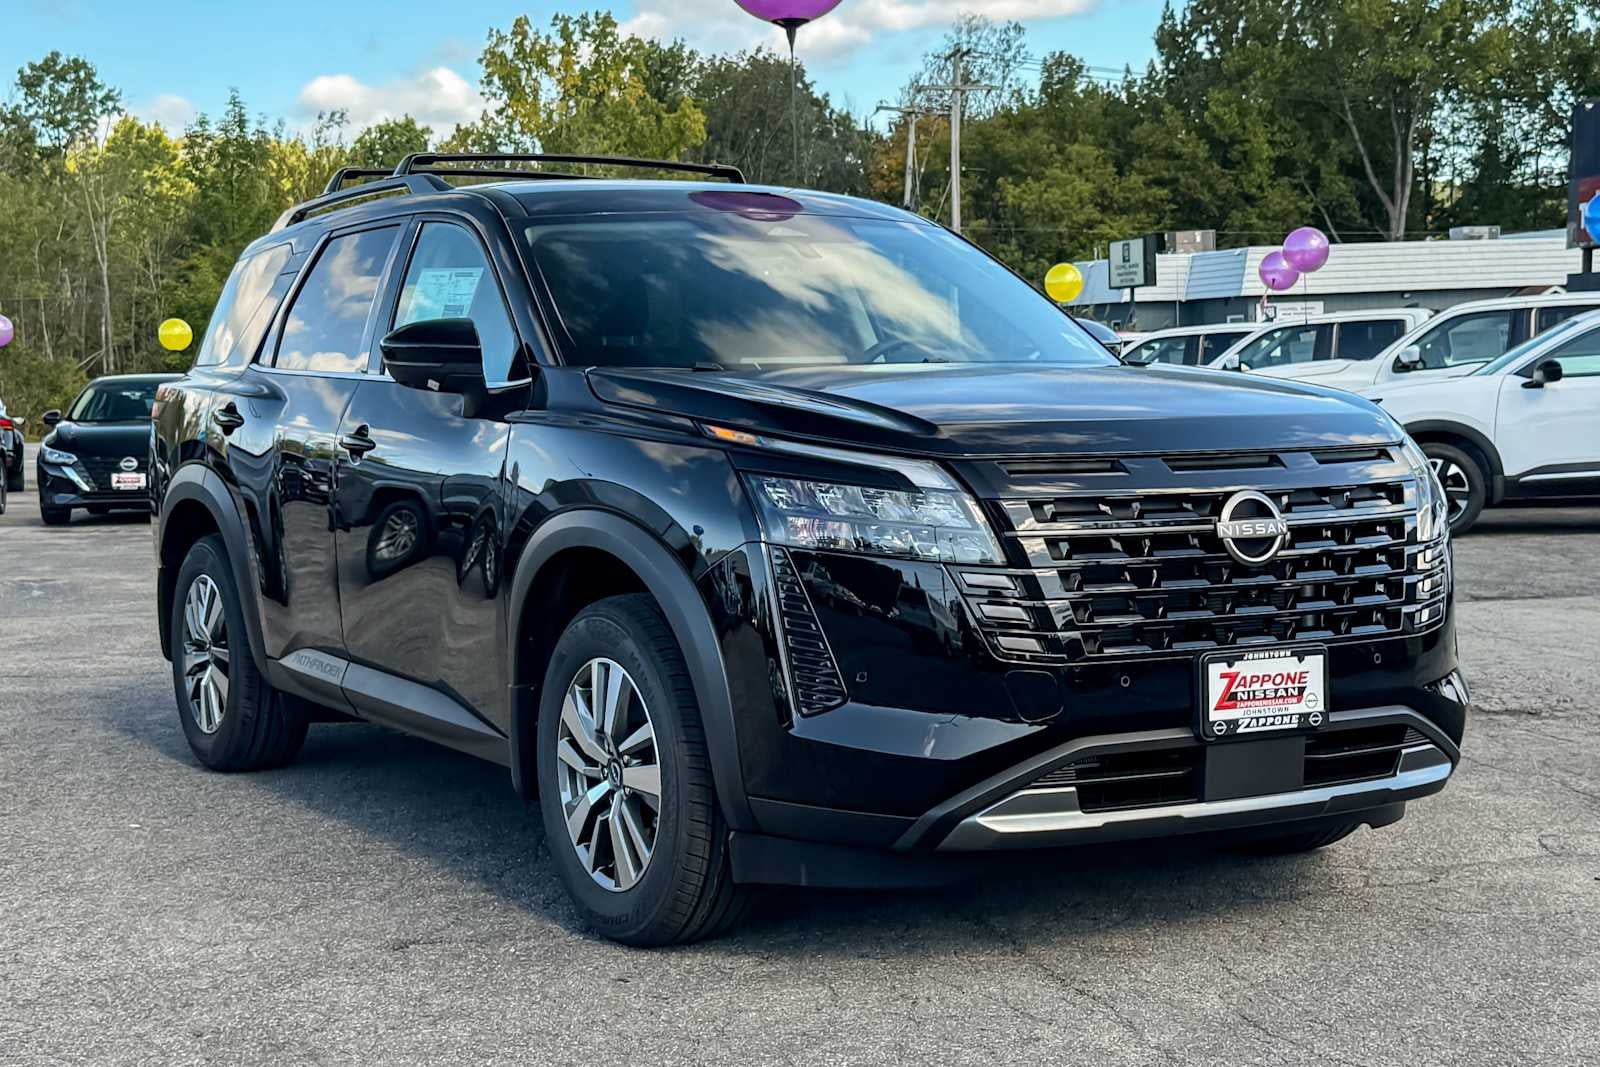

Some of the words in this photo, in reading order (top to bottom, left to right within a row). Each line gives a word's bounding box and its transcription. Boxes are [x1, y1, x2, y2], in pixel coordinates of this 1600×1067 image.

[1219, 522, 1286, 536] NISSAN
[1243, 650, 1291, 660] JOHNSTOWN
[1214, 672, 1309, 711] ZAPPONE
[1237, 688, 1299, 700] NISSAN
[1242, 706, 1289, 717] JOHNSTOWN
[1236, 715, 1299, 733] ZAPPONE
